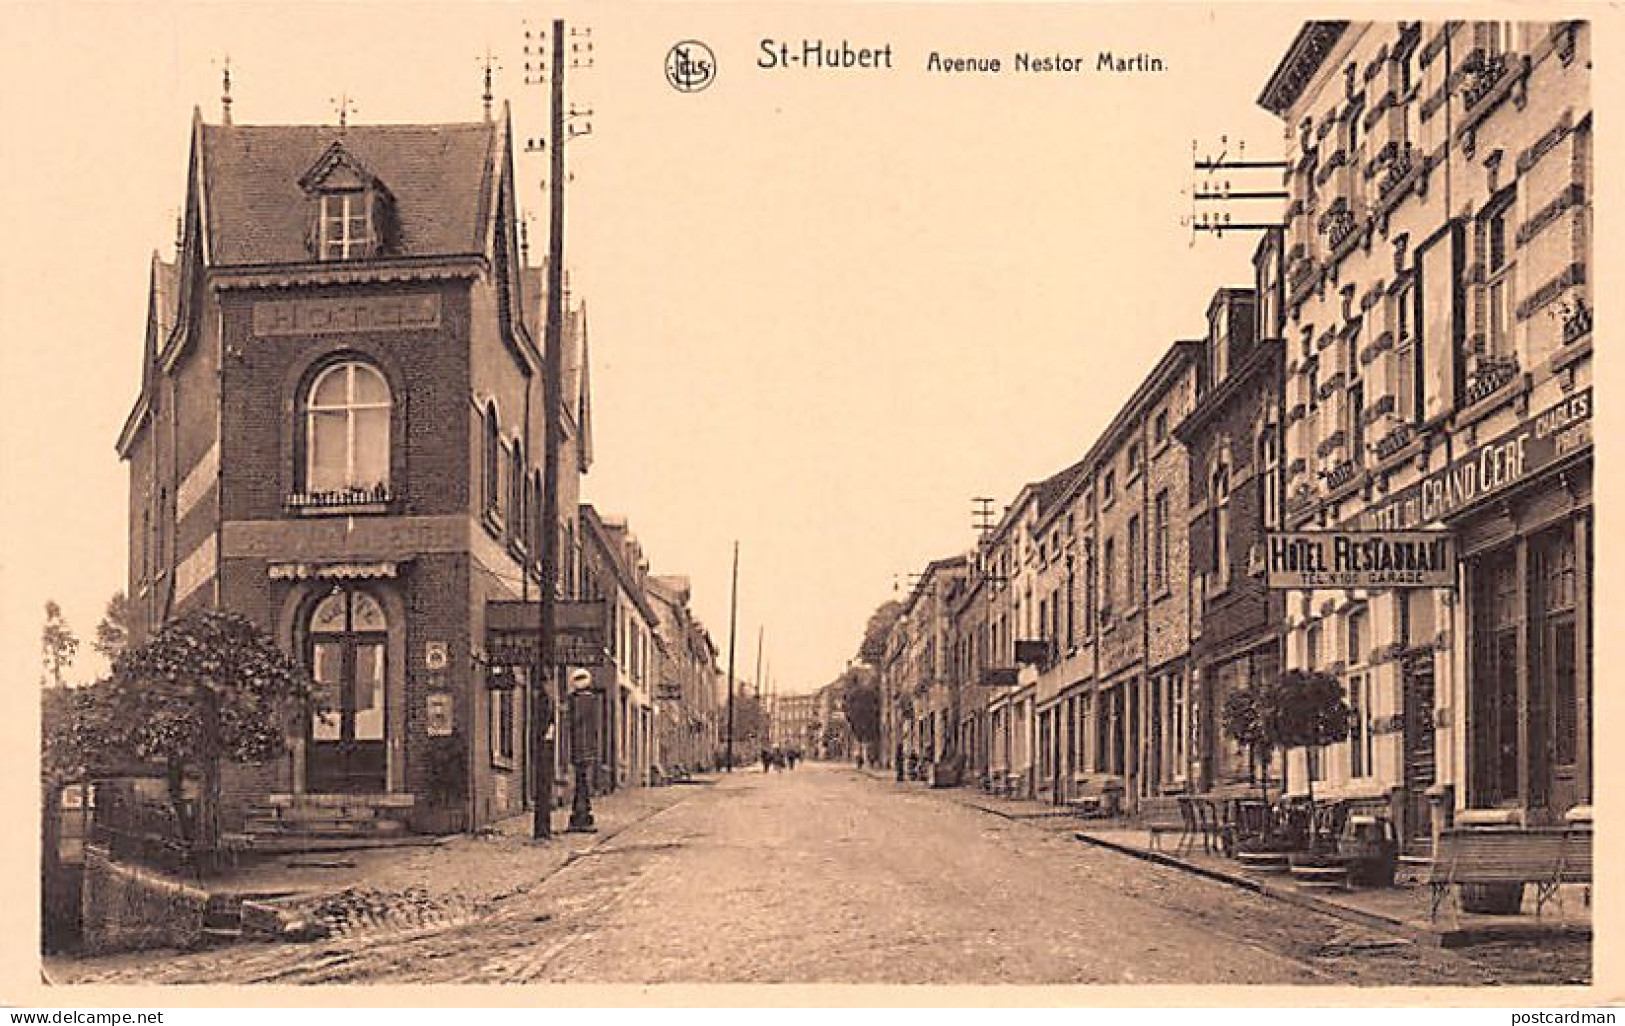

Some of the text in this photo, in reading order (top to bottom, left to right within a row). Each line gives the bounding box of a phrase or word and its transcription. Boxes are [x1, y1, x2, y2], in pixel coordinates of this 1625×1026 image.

[1423, 462, 1476, 521] GRAND
[1480, 433, 1530, 492] CERF
[1271, 536, 1448, 573] HOTEL RESTAURANT
